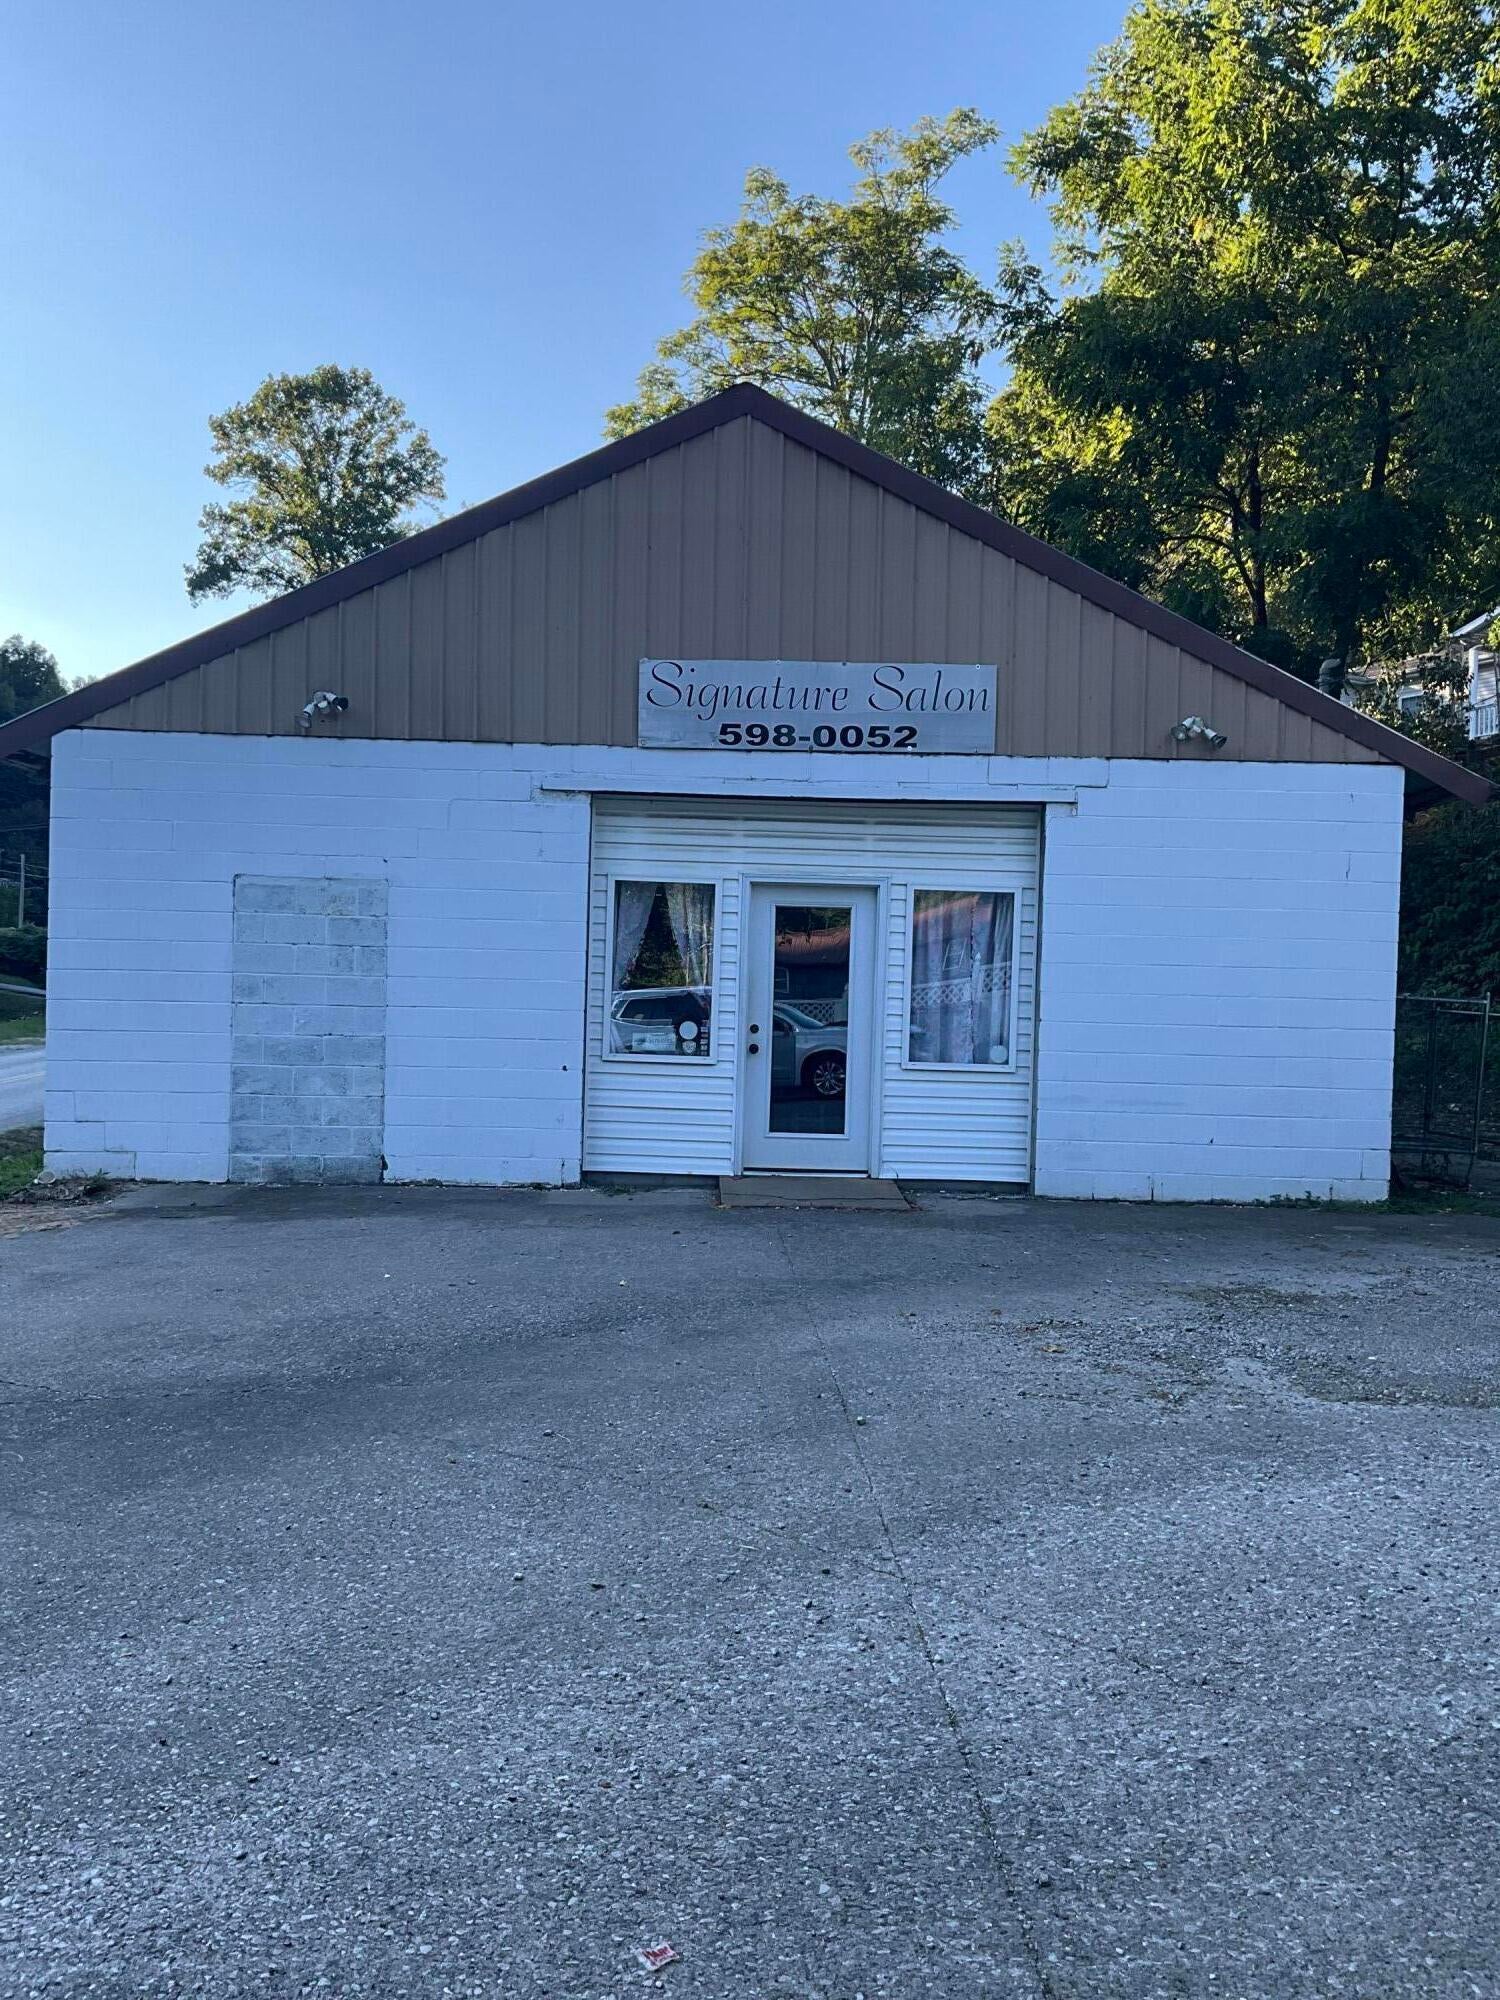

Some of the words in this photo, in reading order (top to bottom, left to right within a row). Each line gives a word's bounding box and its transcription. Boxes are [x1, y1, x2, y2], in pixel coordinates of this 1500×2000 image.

[646, 661, 848, 721] Signature
[868, 665, 991, 712] Salon
[718, 723, 918, 748] 598-0052
